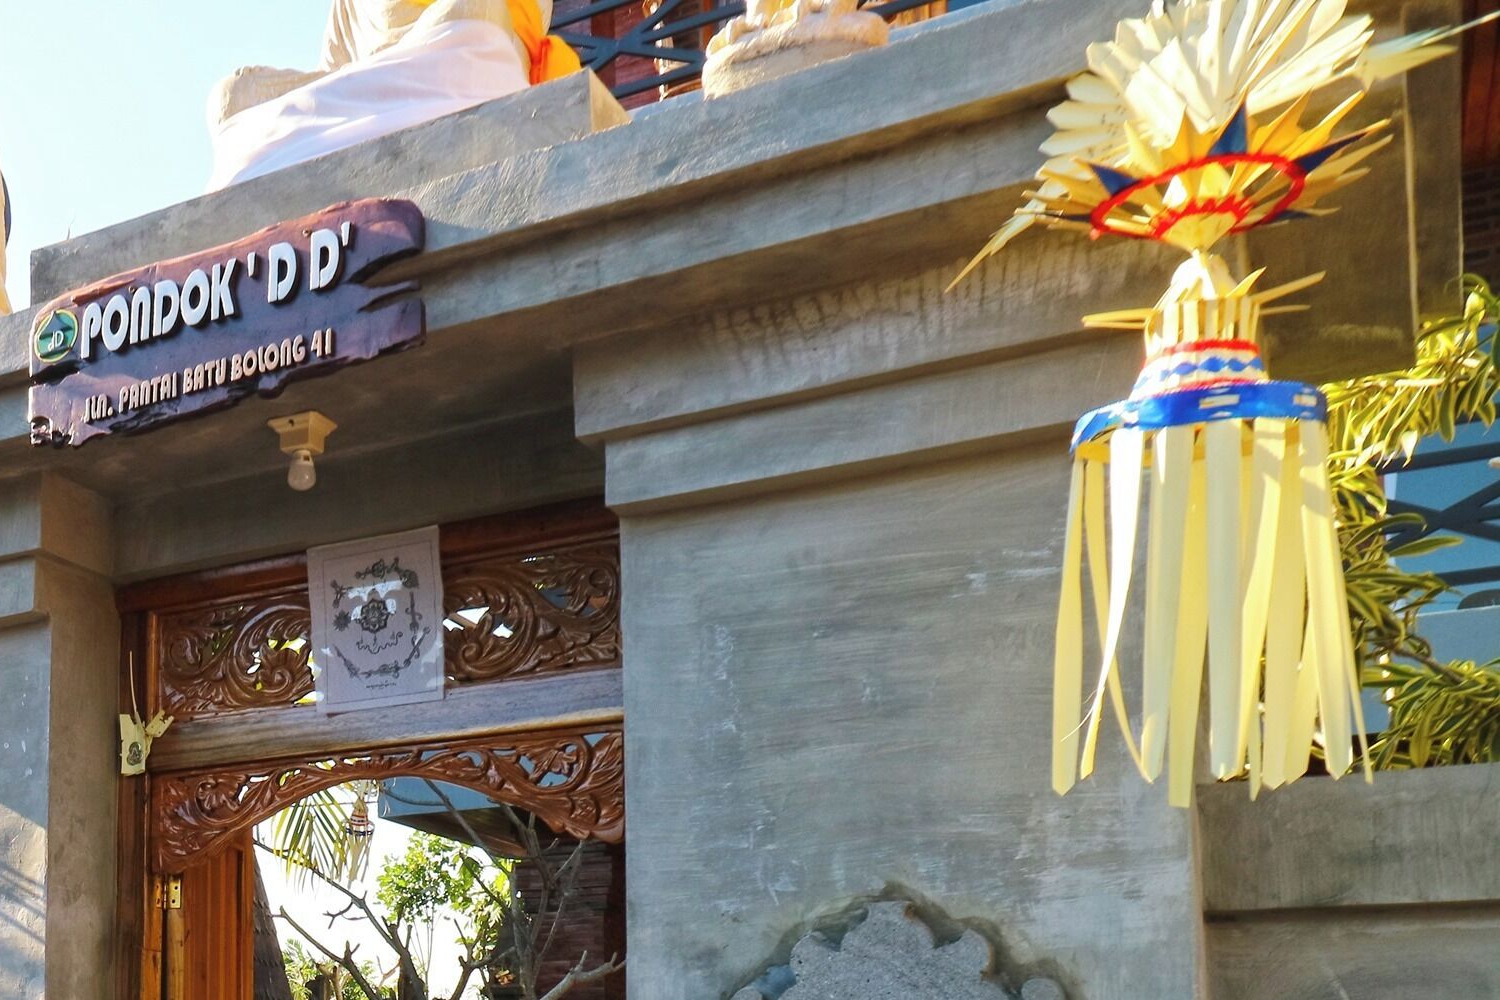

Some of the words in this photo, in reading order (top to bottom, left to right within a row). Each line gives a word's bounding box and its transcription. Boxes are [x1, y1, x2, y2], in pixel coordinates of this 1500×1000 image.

[80, 257, 237, 359] PONDOK
[118, 371, 178, 414] PANTAI
[183, 356, 228, 394] BATU
[231, 334, 306, 382] BOLONG
[310, 327, 333, 358] 41
